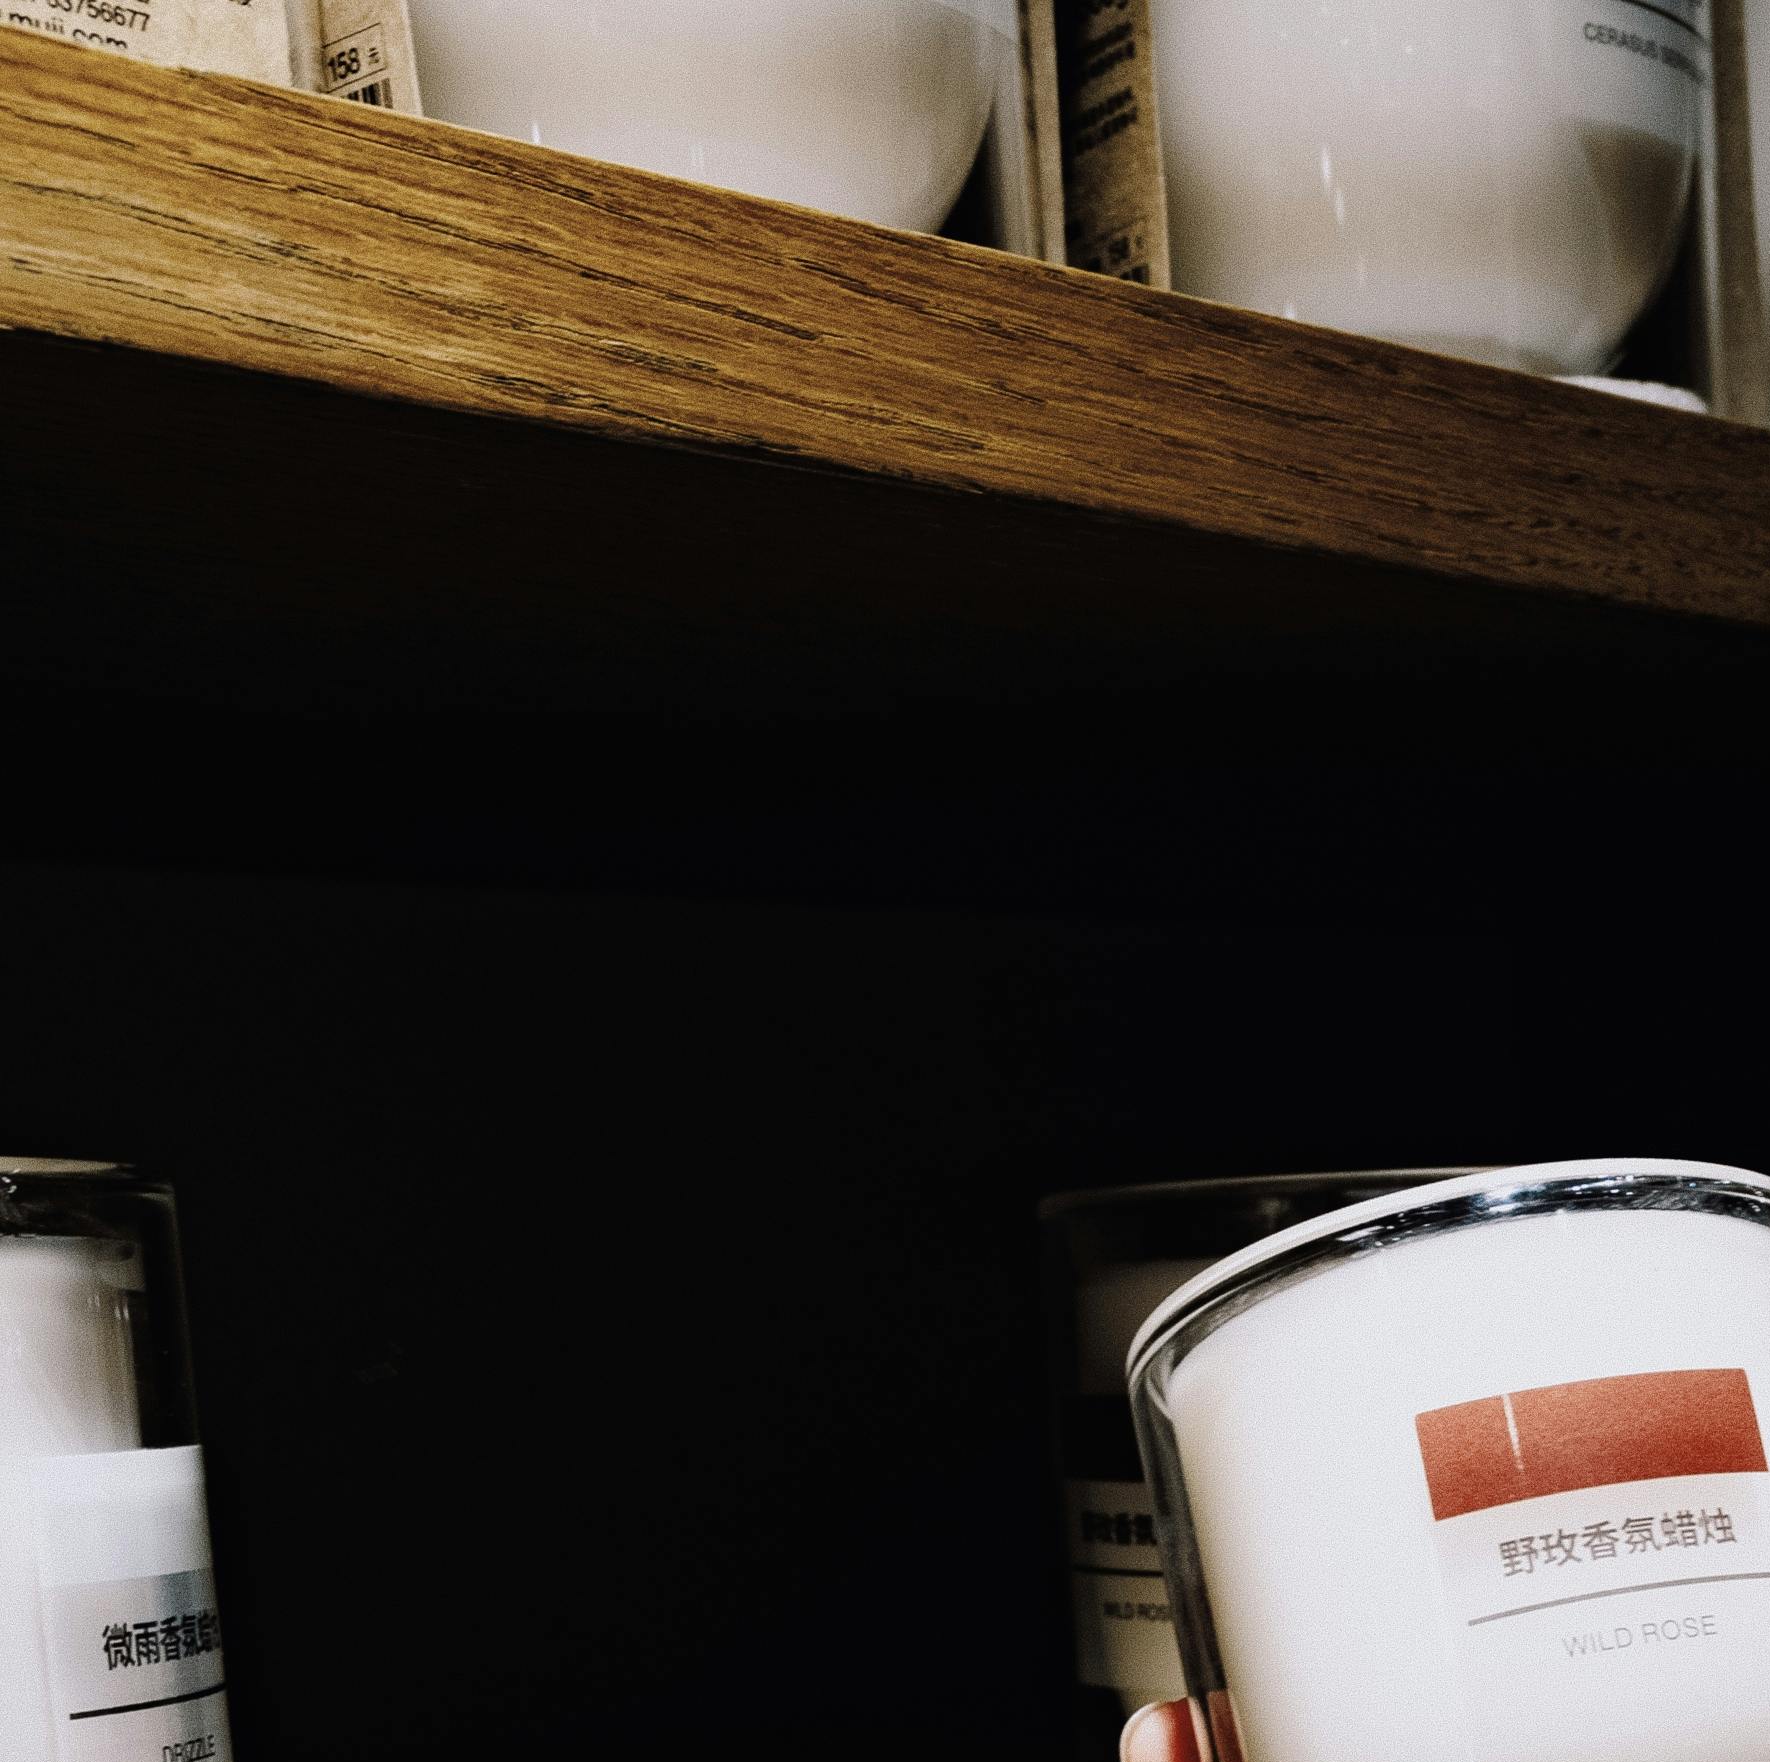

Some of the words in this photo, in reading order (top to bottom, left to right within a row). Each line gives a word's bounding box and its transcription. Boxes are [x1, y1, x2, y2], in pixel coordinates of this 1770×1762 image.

[328, 47, 360, 81] 158
[1499, 1507, 1738, 1578] 野玫香氛蜡烛
[1562, 1627, 1633, 1658] WILD
[1642, 1614, 1718, 1643] ROSE
